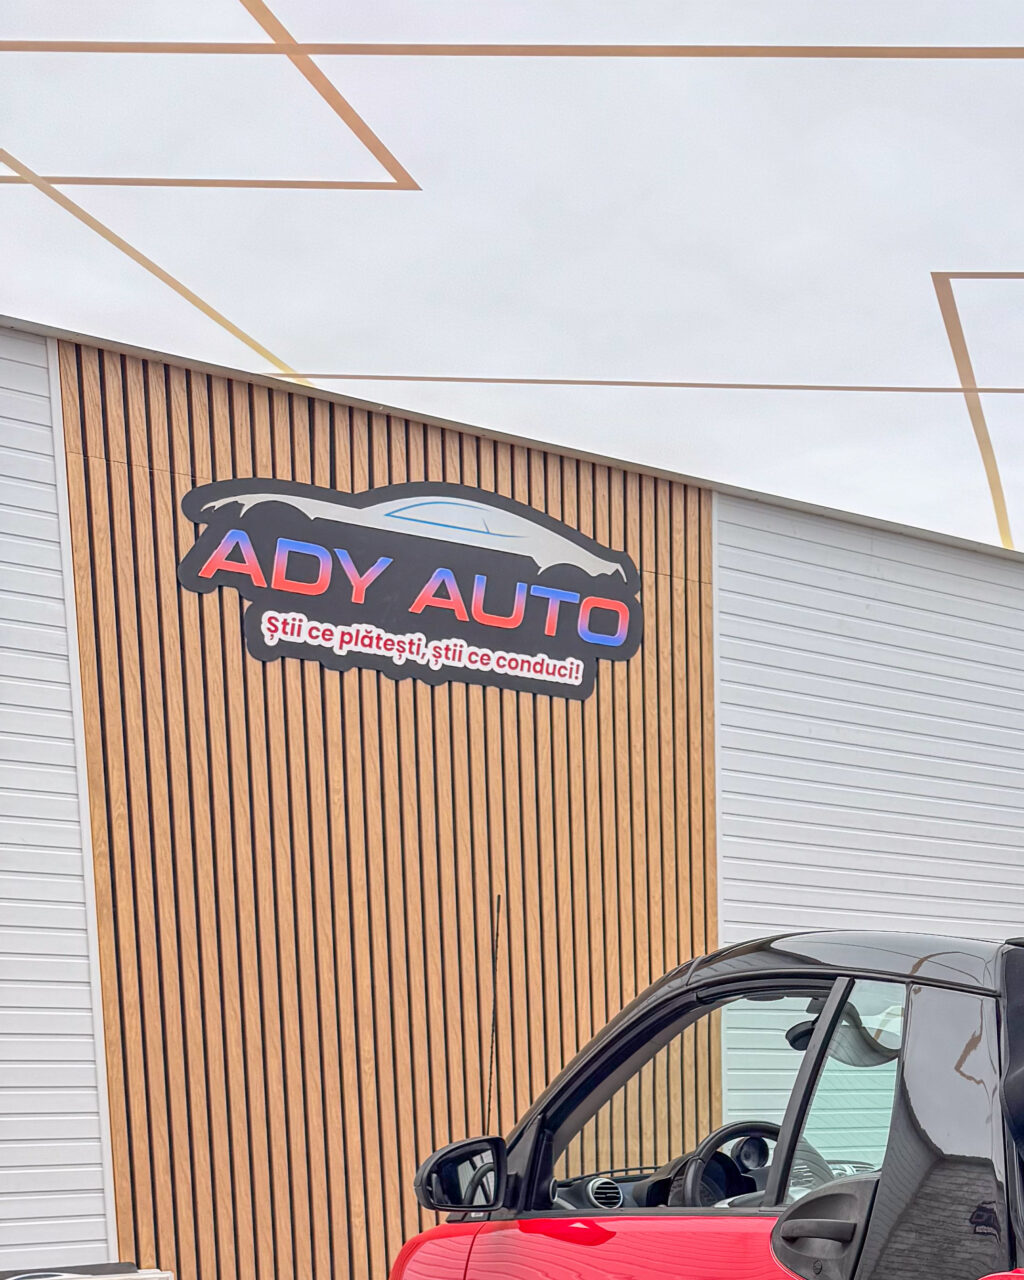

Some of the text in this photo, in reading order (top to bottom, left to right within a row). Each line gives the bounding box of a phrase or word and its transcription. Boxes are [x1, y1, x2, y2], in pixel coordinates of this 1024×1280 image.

[198, 529, 630, 647] ADY AUTO
[266, 615, 581, 680] Știi ce plătești, știi ce conduci!
